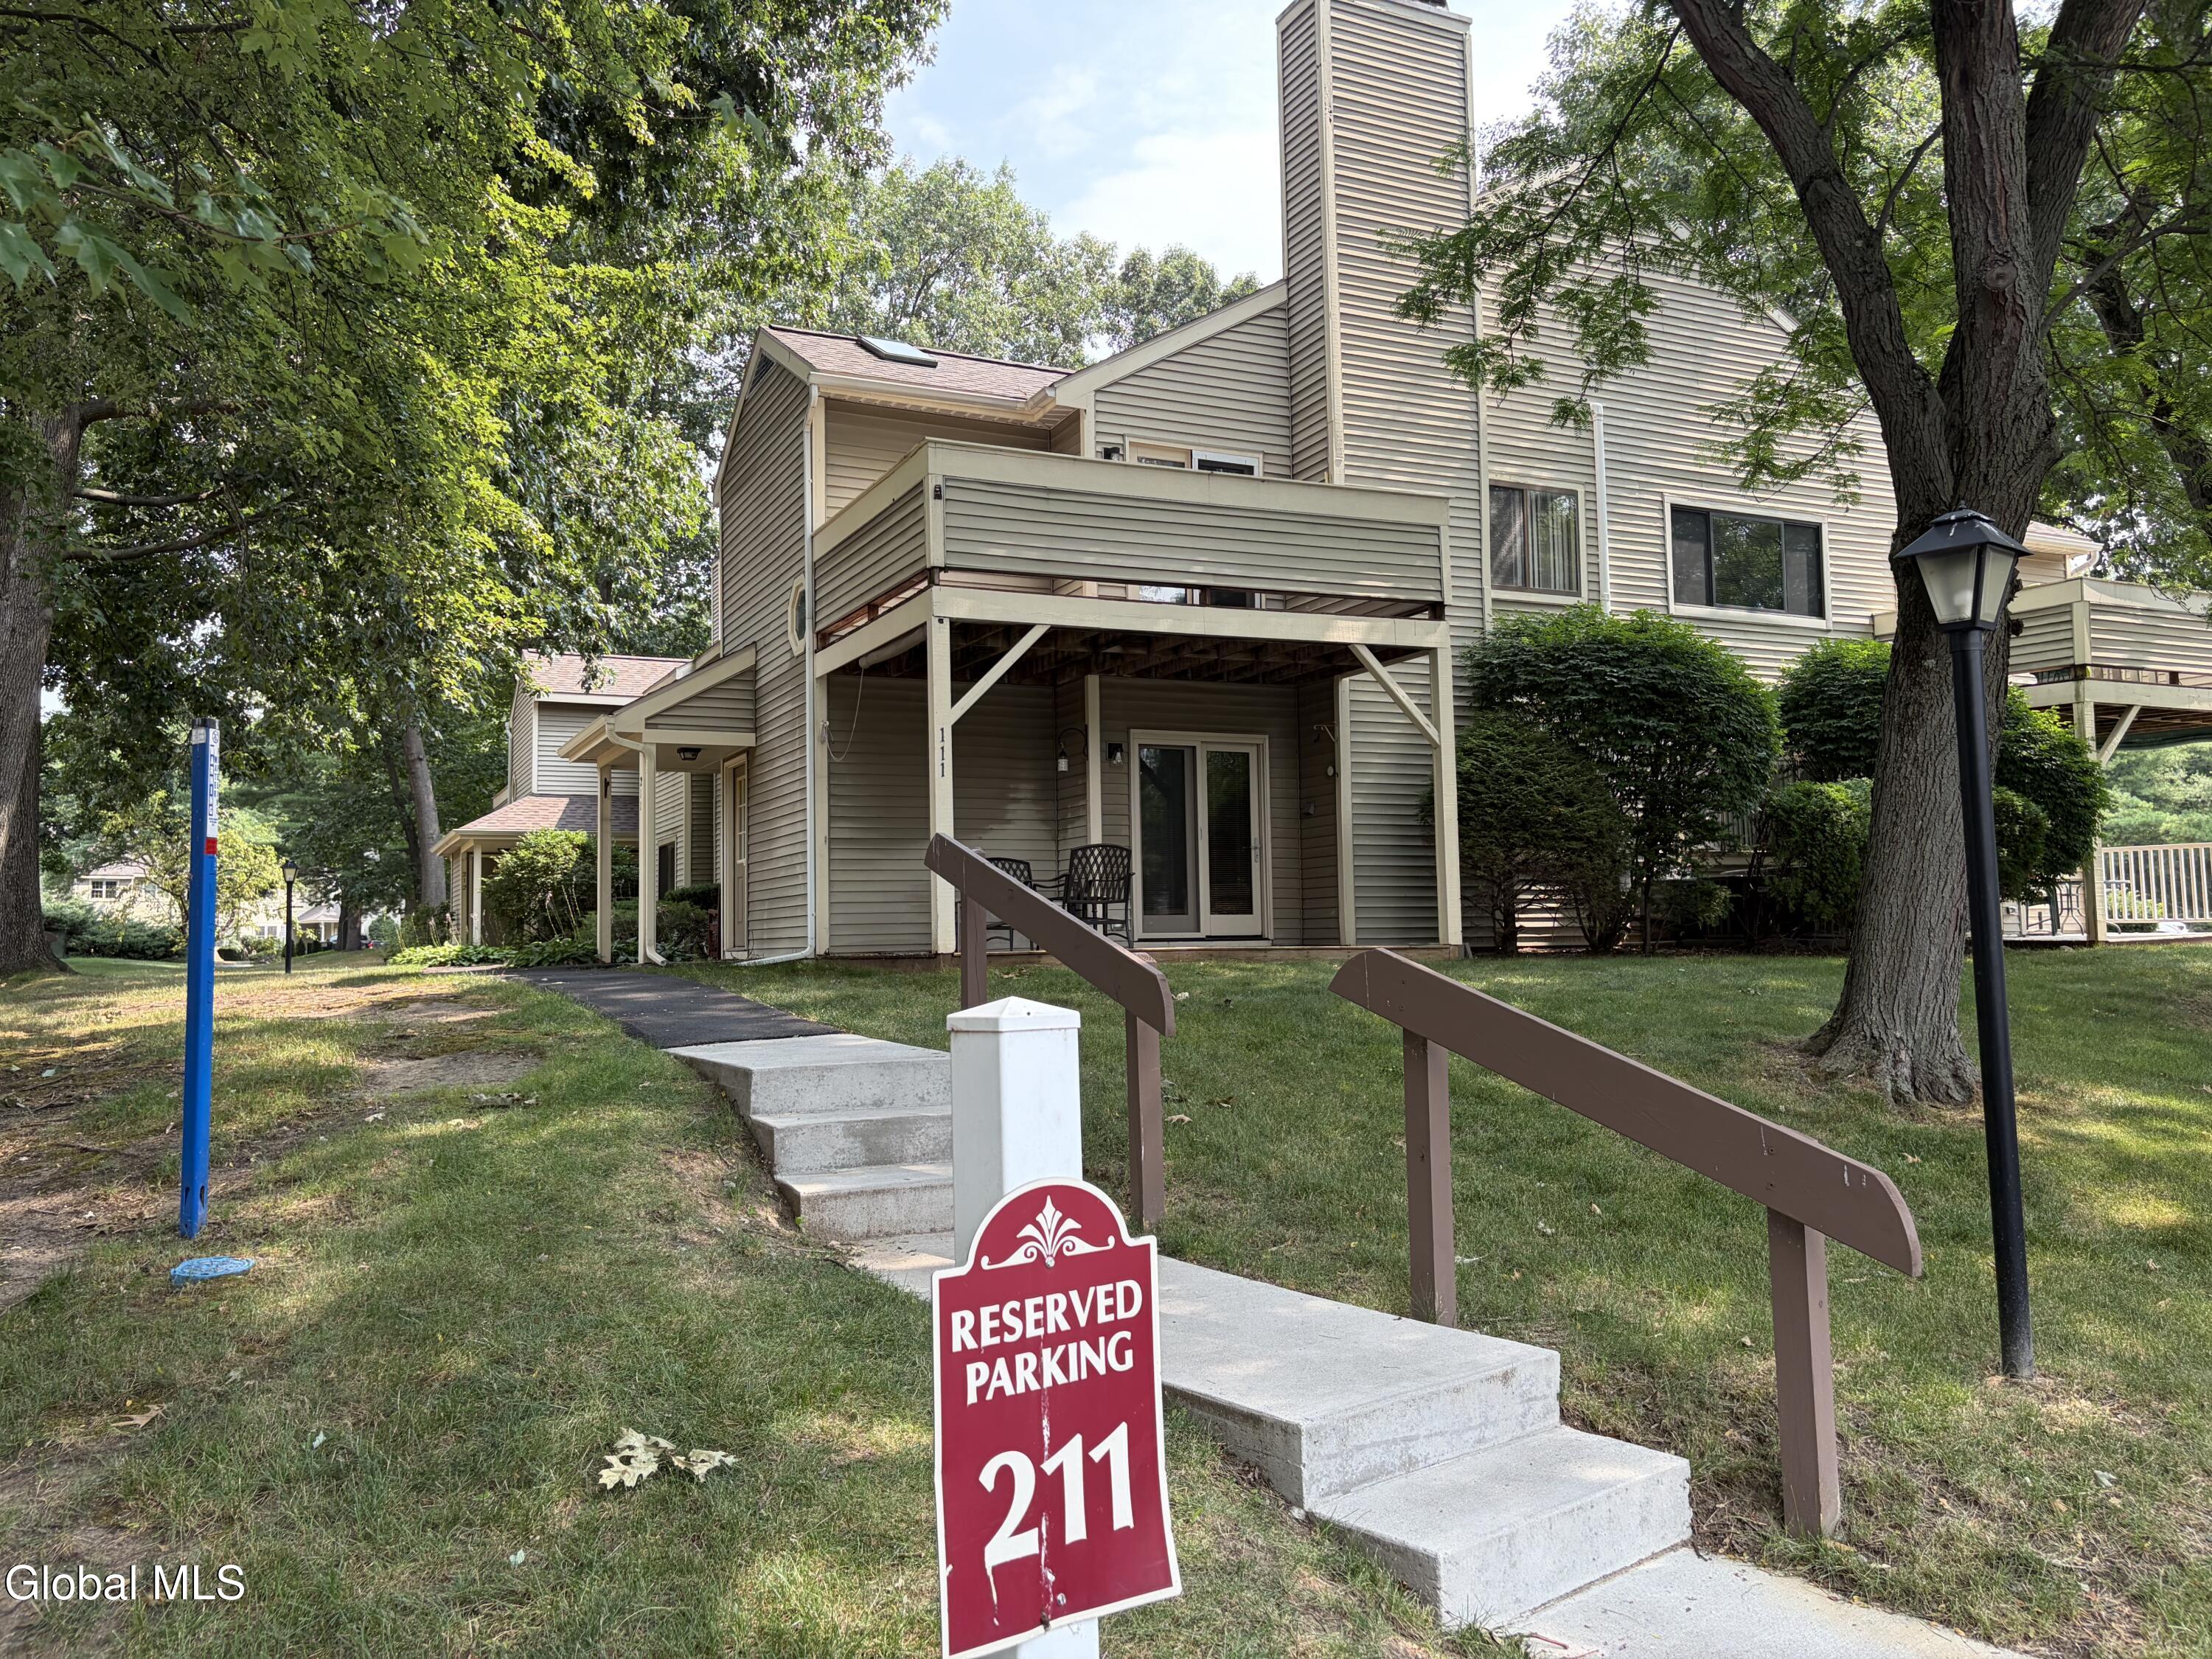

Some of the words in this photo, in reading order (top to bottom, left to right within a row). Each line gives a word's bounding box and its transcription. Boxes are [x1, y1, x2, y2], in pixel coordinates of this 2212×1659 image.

[951, 1279, 1142, 1352] RESERVED
[966, 1331, 1133, 1407] PARKING
[978, 1422, 1134, 1568] 211
